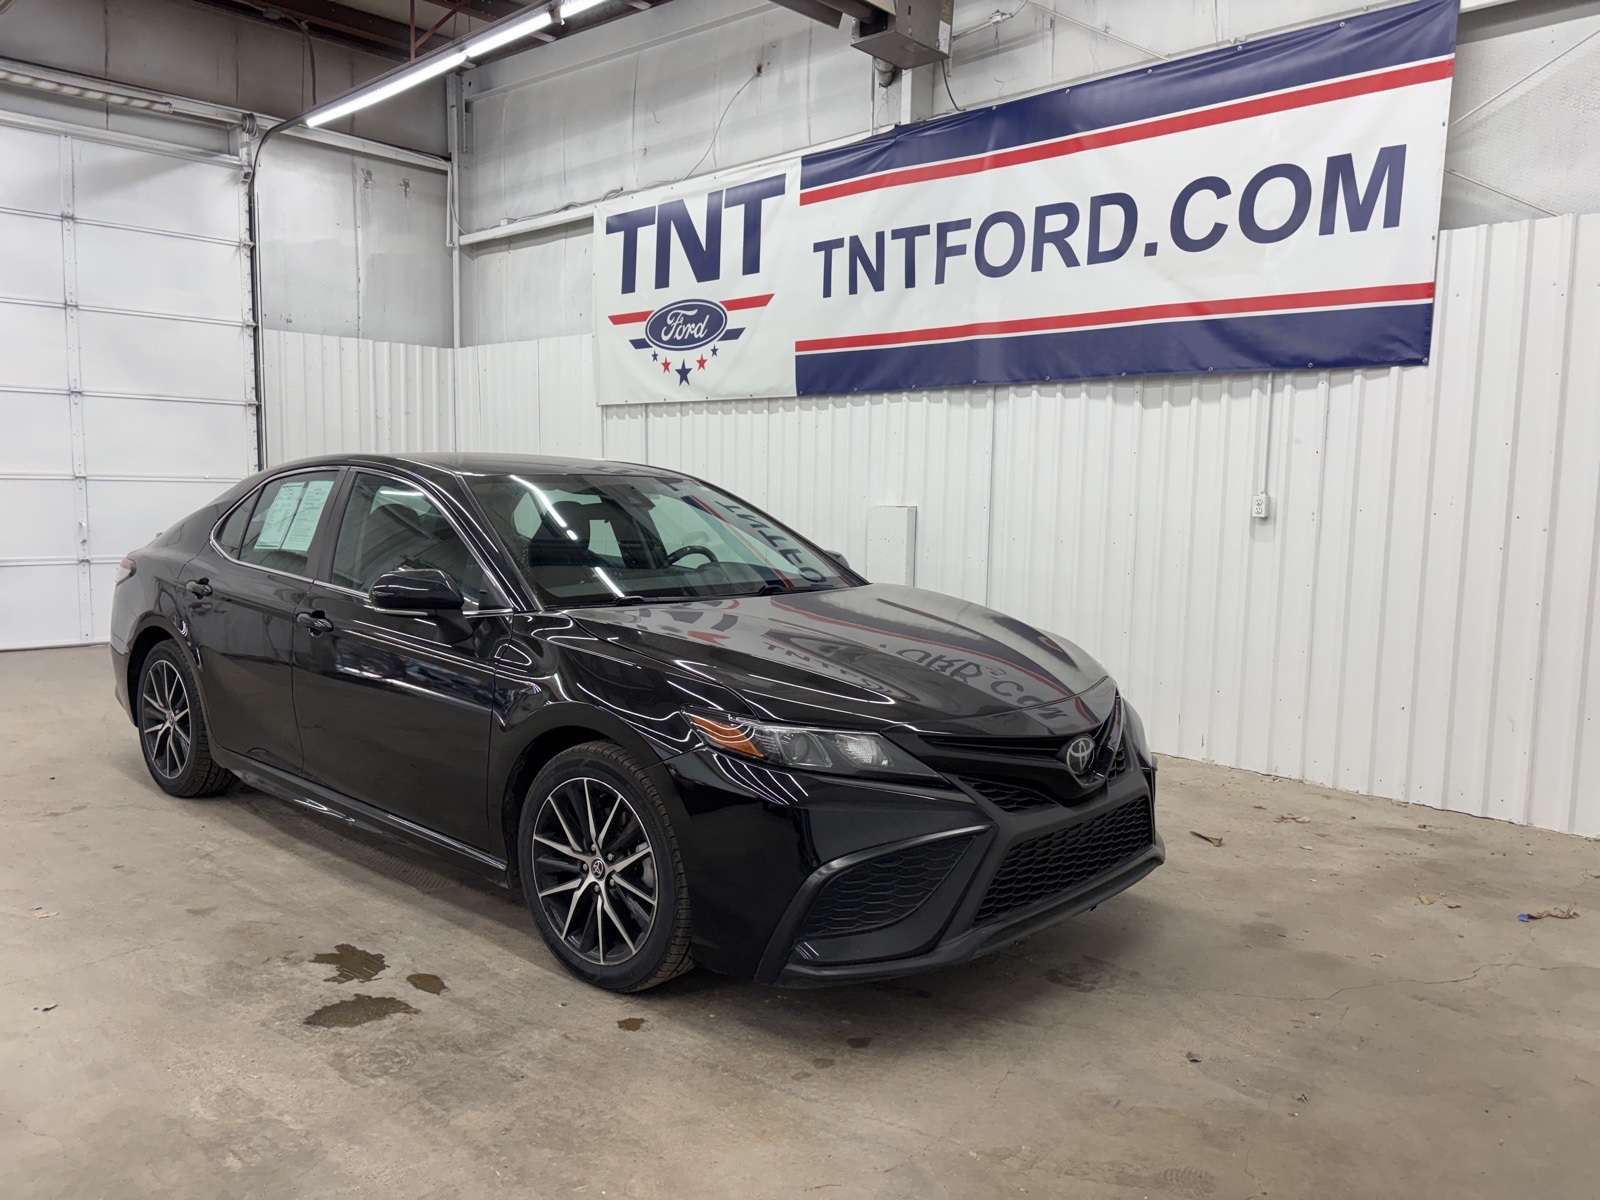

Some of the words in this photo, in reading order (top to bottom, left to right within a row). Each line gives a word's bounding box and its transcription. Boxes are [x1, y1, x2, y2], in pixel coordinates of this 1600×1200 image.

[606, 173, 786, 295] TNT
[813, 144, 1407, 299] TNTFORD.COM
[661, 308, 710, 341] Ford
